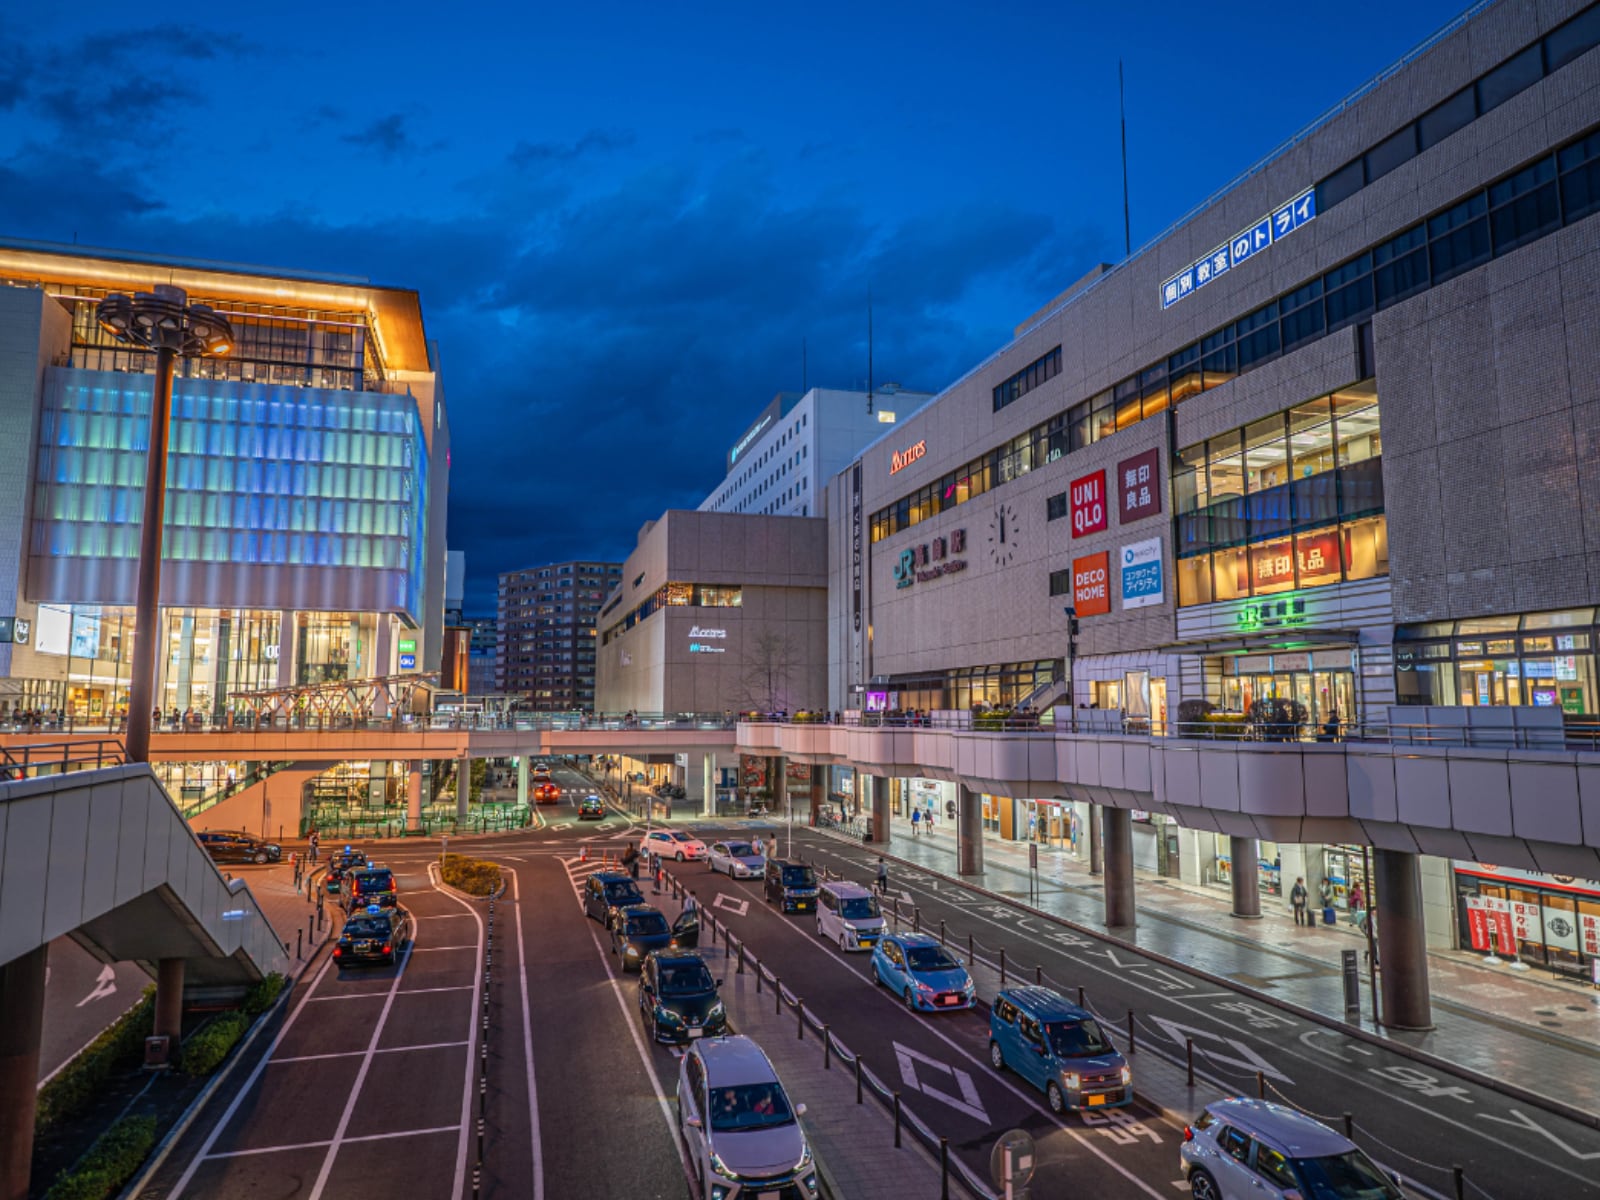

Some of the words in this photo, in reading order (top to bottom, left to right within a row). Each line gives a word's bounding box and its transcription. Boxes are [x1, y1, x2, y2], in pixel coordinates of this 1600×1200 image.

[1125, 464, 1150, 488] 無印
[1073, 479, 1099, 506] UNI
[1126, 487, 1151, 510] 良品
[1075, 503, 1102, 532] QLO
[1076, 568, 1105, 586] DECO
[1125, 577, 1158, 593] アイシティ
[1076, 585, 1105, 602] HOME
